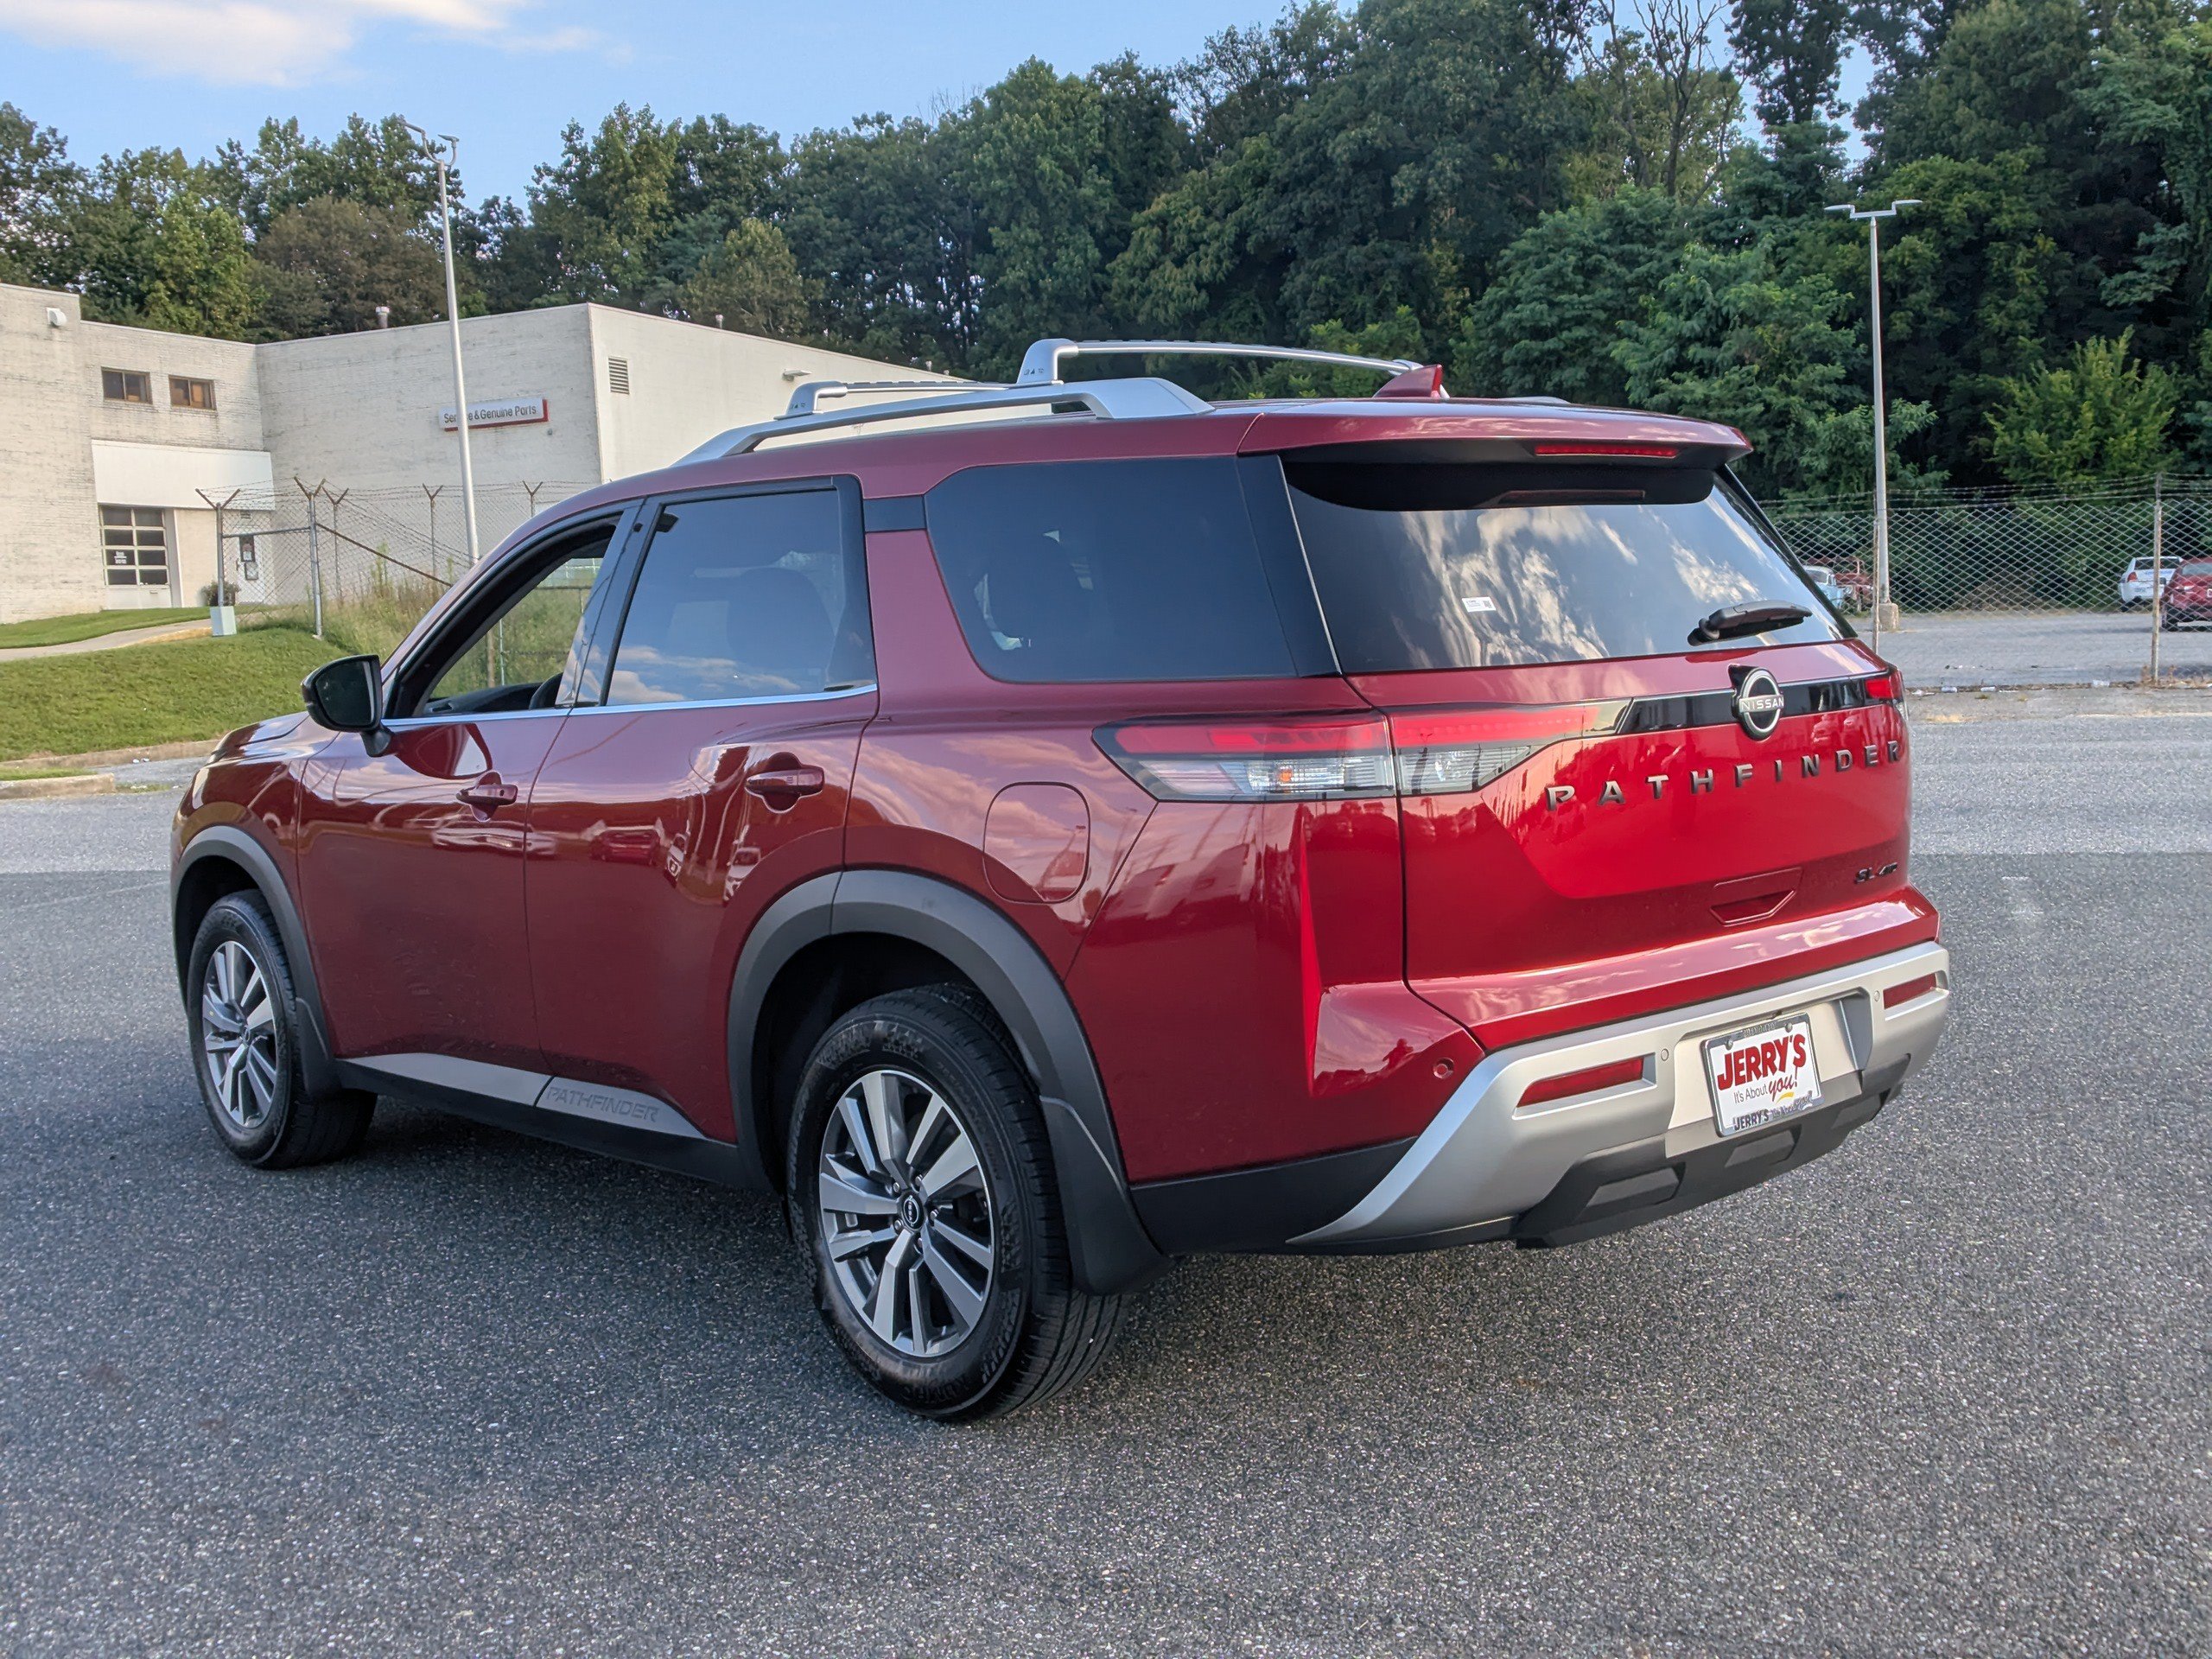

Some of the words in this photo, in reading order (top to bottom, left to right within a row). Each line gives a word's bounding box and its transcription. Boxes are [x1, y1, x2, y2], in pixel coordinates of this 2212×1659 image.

[443, 412, 474, 423] Sere
[474, 410, 480, 420] &
[480, 408, 513, 420] Genuine
[514, 405, 537, 416] Parts
[1741, 696, 1784, 710] NISSAN
[1545, 740, 1901, 811] PATHFINDER
[1717, 1033, 1807, 1091] JERRY'S
[1733, 1090, 1745, 1104] It's
[1745, 1083, 1768, 1101] About
[1768, 1067, 1798, 1102] you!
[546, 1086, 660, 1122] PATHFINDER
[1732, 1109, 1770, 1131] JERRY'S
